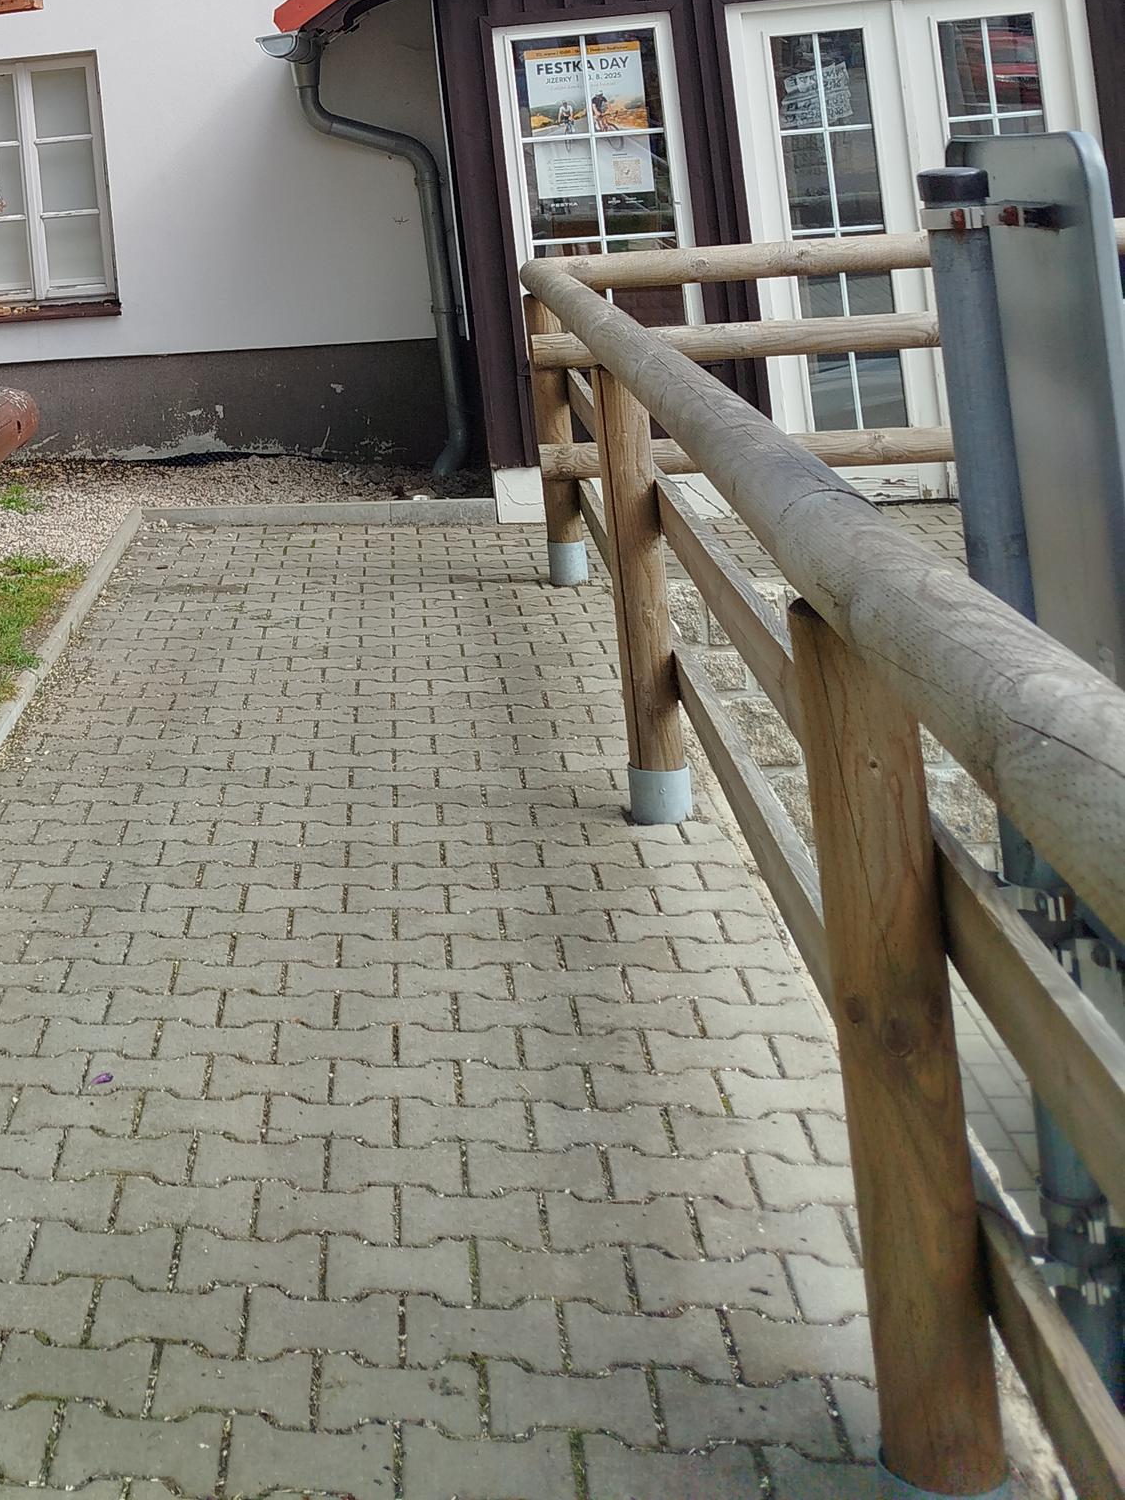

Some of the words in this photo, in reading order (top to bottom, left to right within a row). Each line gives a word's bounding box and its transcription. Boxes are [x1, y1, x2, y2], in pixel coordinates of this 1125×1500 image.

[536, 59, 595, 75] FESTKA
[600, 56, 629, 70] DAY
[546, 75, 572, 84] JIZERKY
[605, 71, 622, 79] 2025
